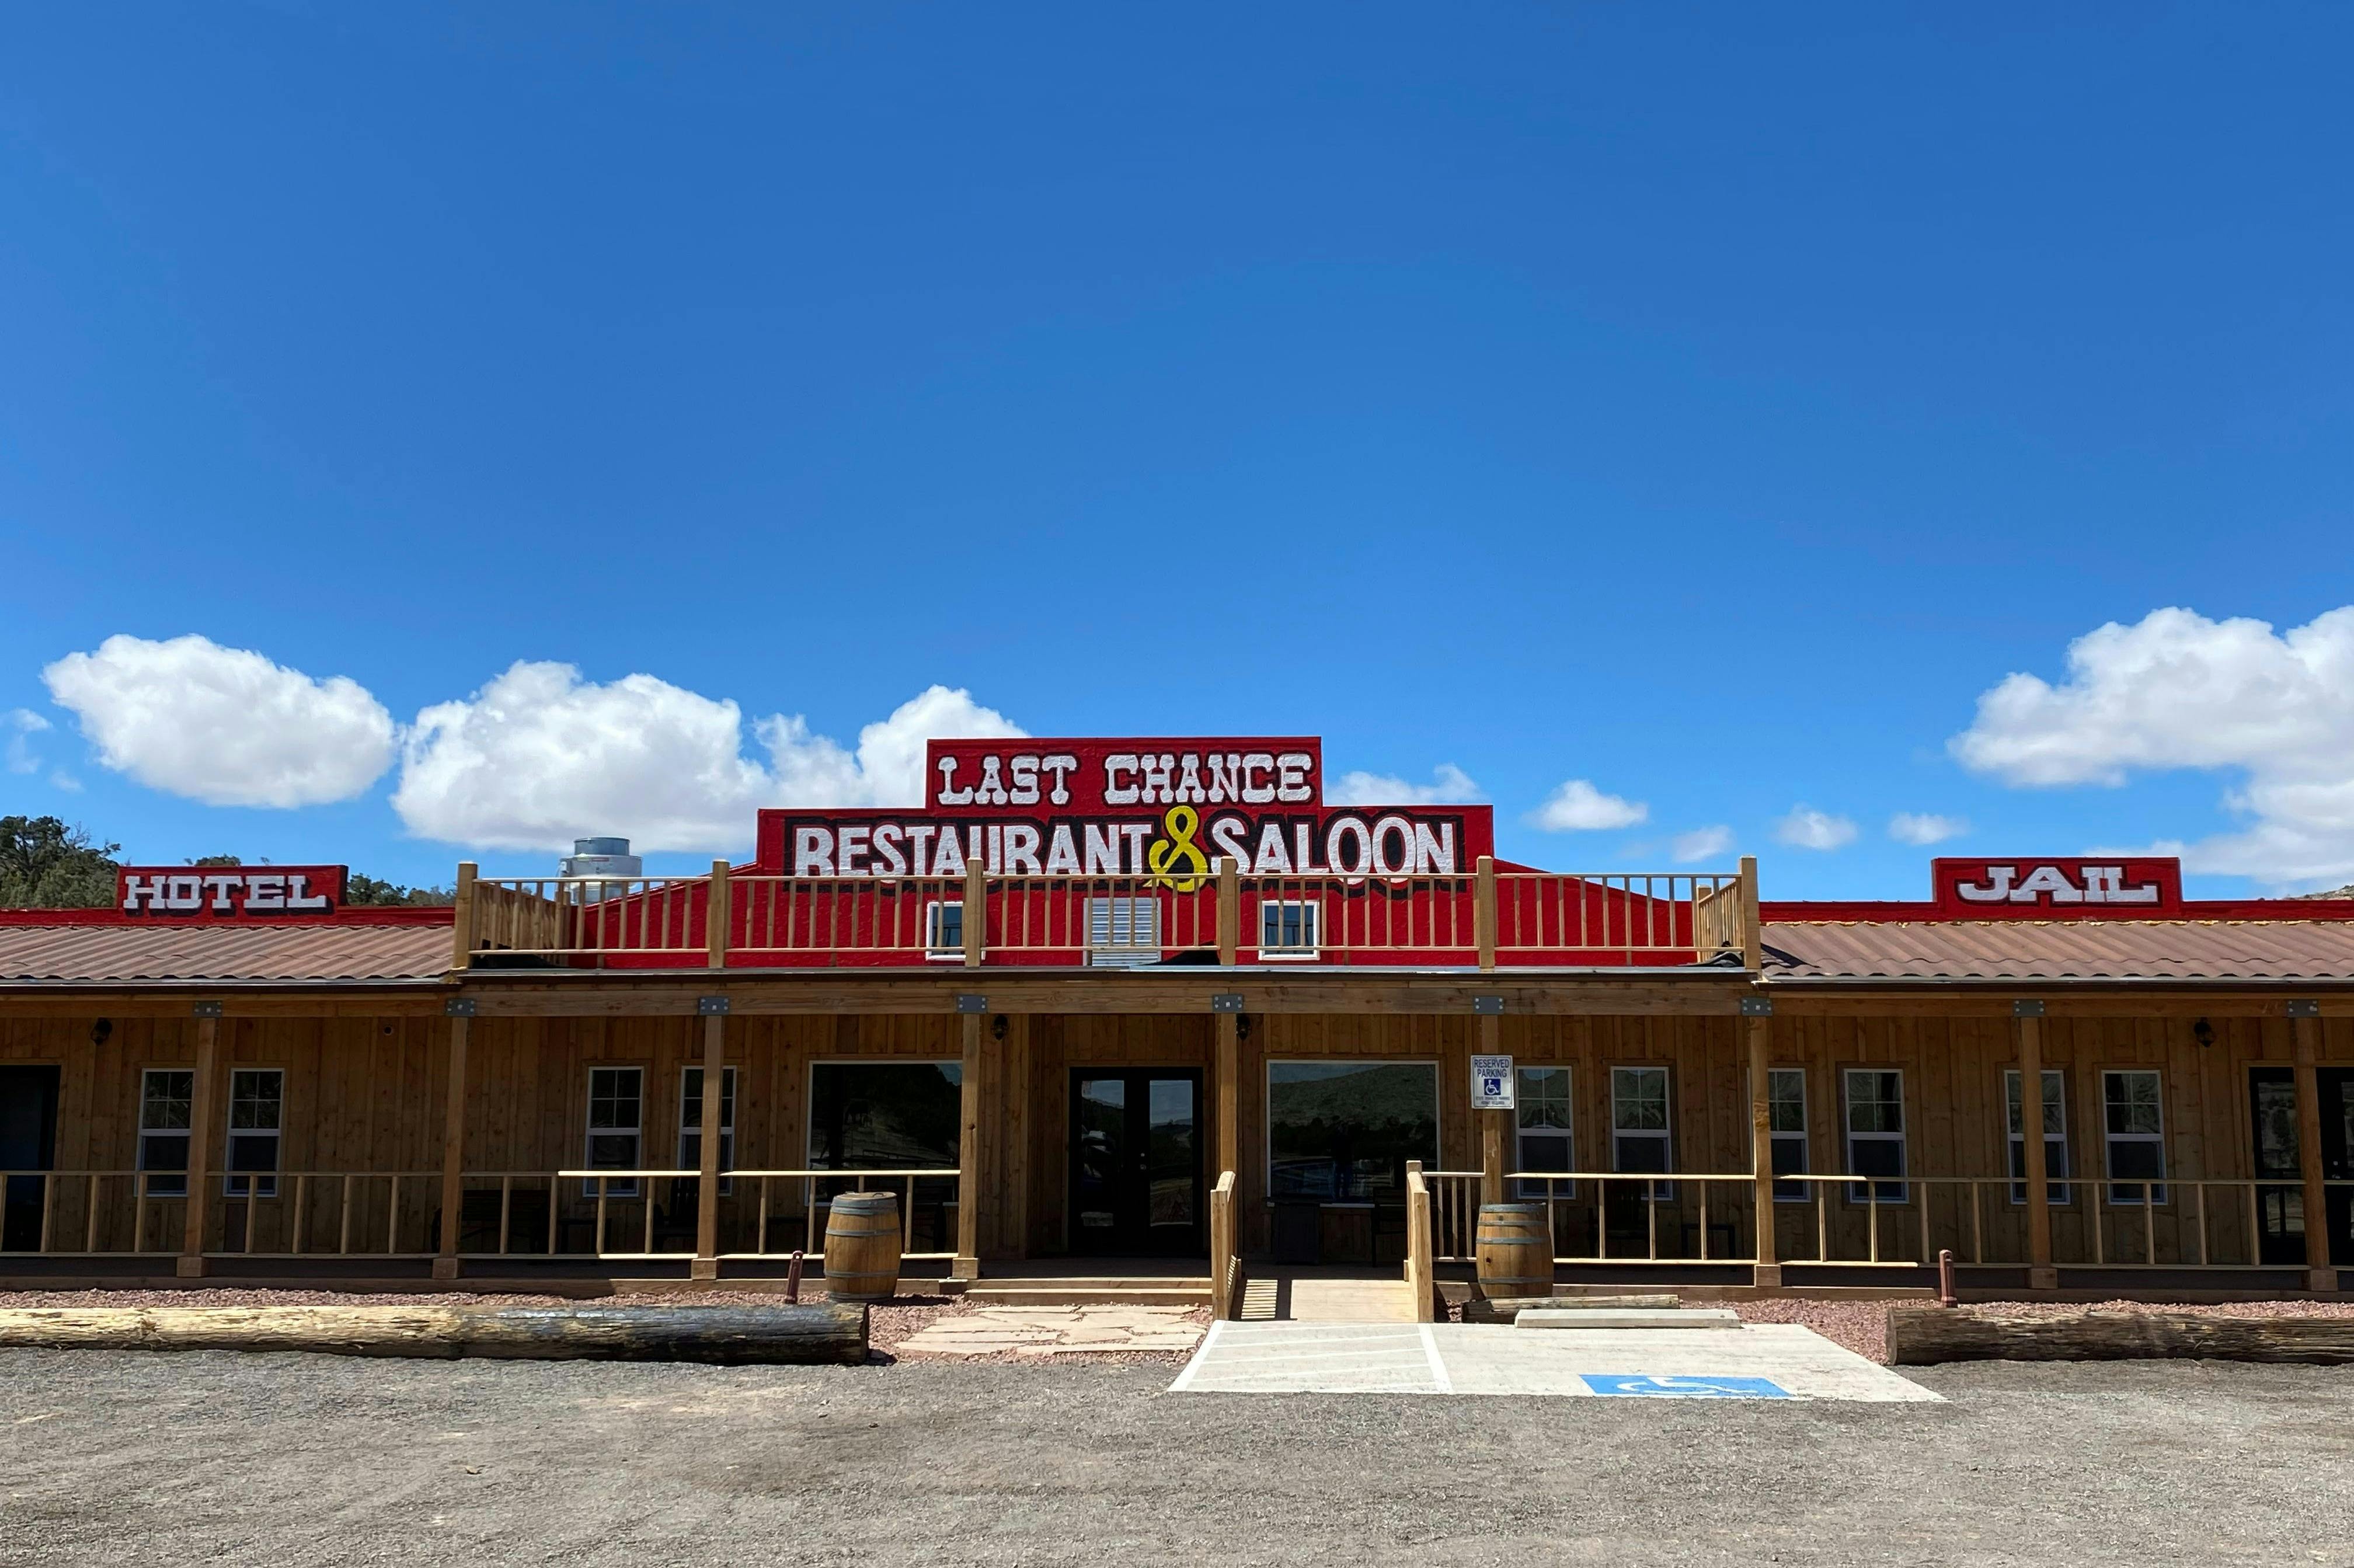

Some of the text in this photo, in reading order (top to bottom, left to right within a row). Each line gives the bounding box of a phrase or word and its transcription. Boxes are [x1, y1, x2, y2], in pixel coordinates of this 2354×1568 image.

[938, 754, 1312, 805] LAST CHANCE
[794, 805, 1455, 892] RESTAURANT & SALOON
[123, 875, 326, 910] HOTEL
[1958, 867, 2158, 903] JAIL
[1474, 1059, 1509, 1068] RESERVED
[1477, 1069, 1507, 1078] PARKING
